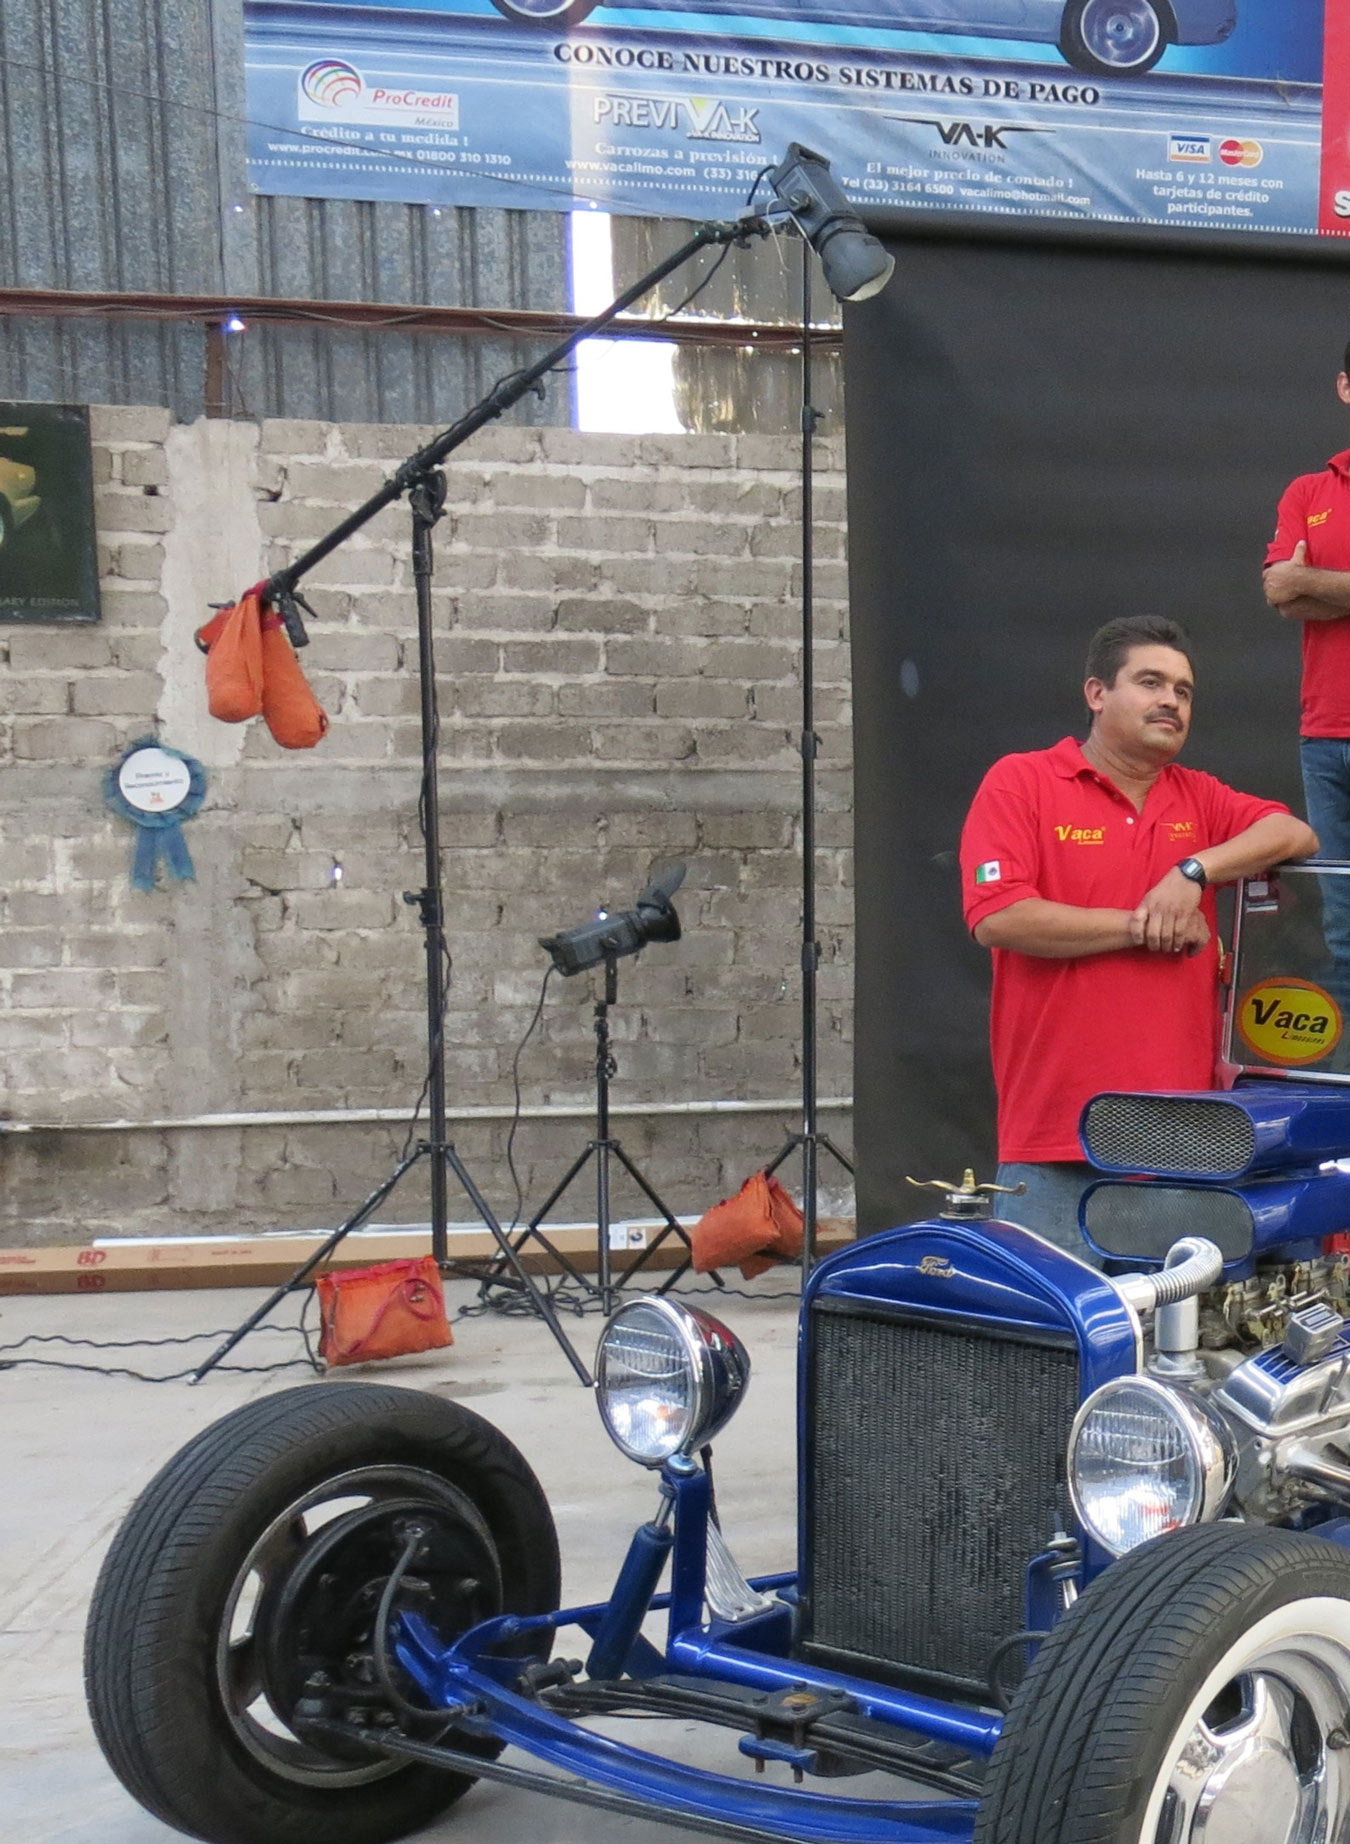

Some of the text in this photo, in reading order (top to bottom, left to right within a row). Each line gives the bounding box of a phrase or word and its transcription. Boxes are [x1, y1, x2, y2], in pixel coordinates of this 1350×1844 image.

[554, 43, 1100, 105] CONOCE NUESTROS SISTEMAS DE PAGO
[373, 89, 453, 108] ProCredit
[414, 117, 454, 128] México
[365, 133, 375, 142] a
[380, 132, 397, 143] tu
[401, 133, 459, 147] medida
[1176, 143, 1206, 155] VISA
[267, 141, 412, 160] www.procredit.commx
[416, 149, 456, 162] 01800
[460, 152, 482, 164] 310
[595, 141, 669, 159] Carrozas
[673, 151, 685, 161] a
[690, 149, 768, 167] previsión
[929, 150, 1006, 164] INNOVATION
[565, 159, 696, 178] www.vacalimo.com
[703, 167, 732, 180] (33)
[866, 162, 882, 174] El
[886, 164, 930, 180] mejor
[934, 168, 981, 184] precio
[985, 171, 1002, 184] de
[1006, 174, 1065, 188] contado
[1136, 168, 1284, 190] Hasta 6 y 12 meses con
[841, 176, 861, 189] Tel
[892, 180, 922, 193] 3164
[925, 182, 954, 195] 6500
[959, 186, 1091, 206] vacalimo@hotmail.com
[1153, 185, 1270, 203] tarjetas de crédito
[1167, 202, 1254, 218] participantes.
[1054, 824, 1103, 841] Vaca
[1250, 998, 1330, 1034] Vaca
